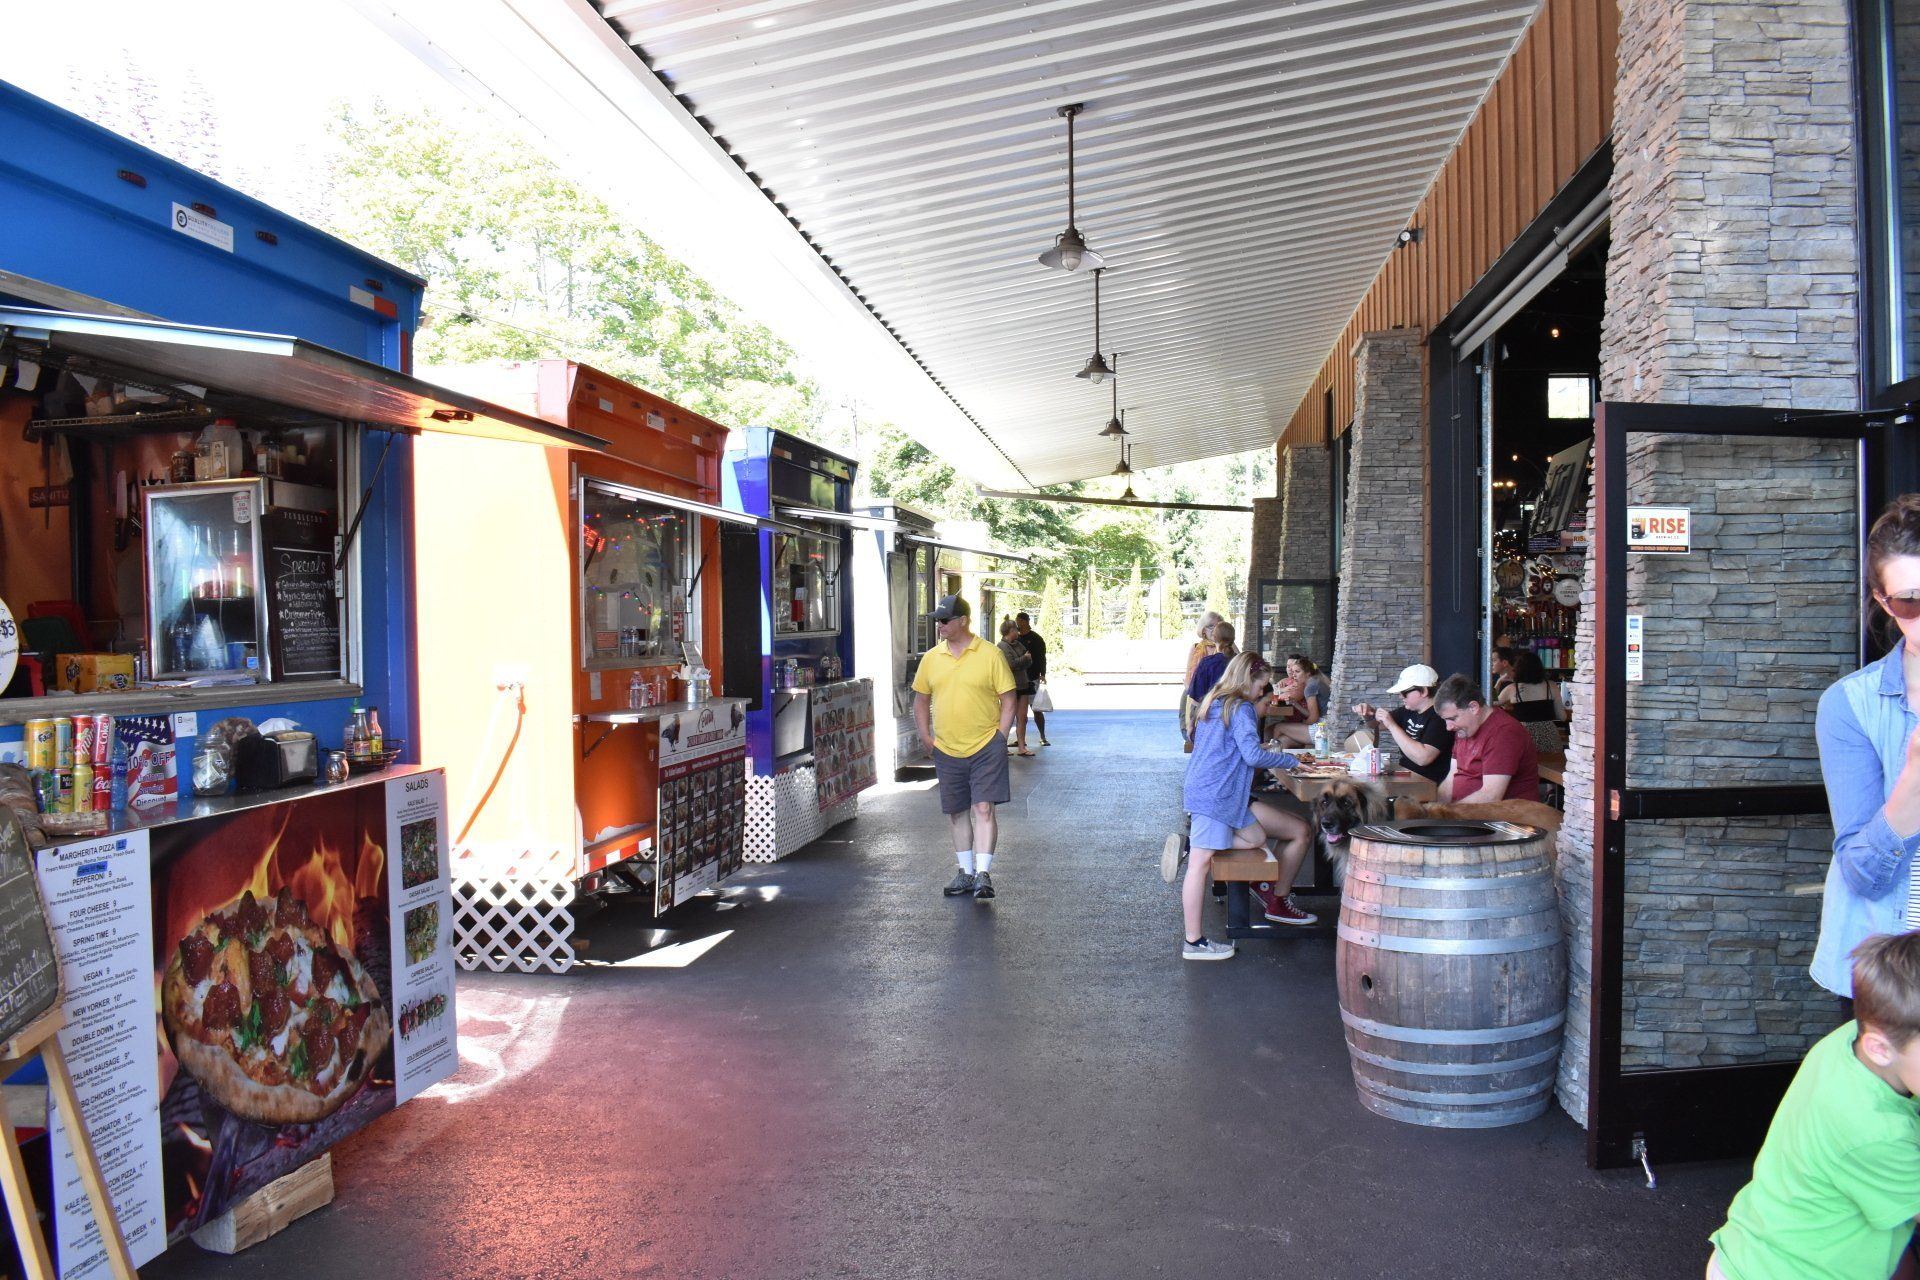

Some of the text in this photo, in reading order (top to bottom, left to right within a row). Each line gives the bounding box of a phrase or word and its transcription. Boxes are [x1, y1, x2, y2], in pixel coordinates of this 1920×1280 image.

[1649, 518, 1686, 534] RISE
[280, 554, 326, 579] Specials
[99, 721, 110, 745] Coke
[128, 751, 171, 770] 10% OFF
[405, 778, 428, 792] SALADS
[136, 796, 167, 807] Discount
[59, 843, 115, 861] MARGHERITA PIZZA
[72, 872, 104, 886] PEPPERONI
[121, 881, 133, 889] Sauce
[56, 889, 68, 898] Fresh
[69, 899, 116, 919] FOUR CHEESE 9
[107, 913, 121, 922] Sauce
[73, 927, 116, 947] SPRING TIME 9
[83, 969, 102, 982] VEGAN
[8, 981, 28, 1013] Pizza
[73, 1006, 86, 1018] NEW
[87, 997, 110, 1012] YORKER
[72, 1030, 95, 1046] DOUBLE
[96, 1023, 113, 1037] DOWN
[93, 1055, 119, 1073] SAUSAGE
[90, 1085, 115, 1104] CHICKEN
[91, 1117, 120, 1139] ACONATOR
[103, 1145, 120, 1160] SMITH
[64, 1197, 80, 1213] KALE
[121, 1165, 135, 1181] PIZZA
[64, 1251, 98, 1280] CUSTOMERS
[132, 1221, 146, 1238] WEEK
